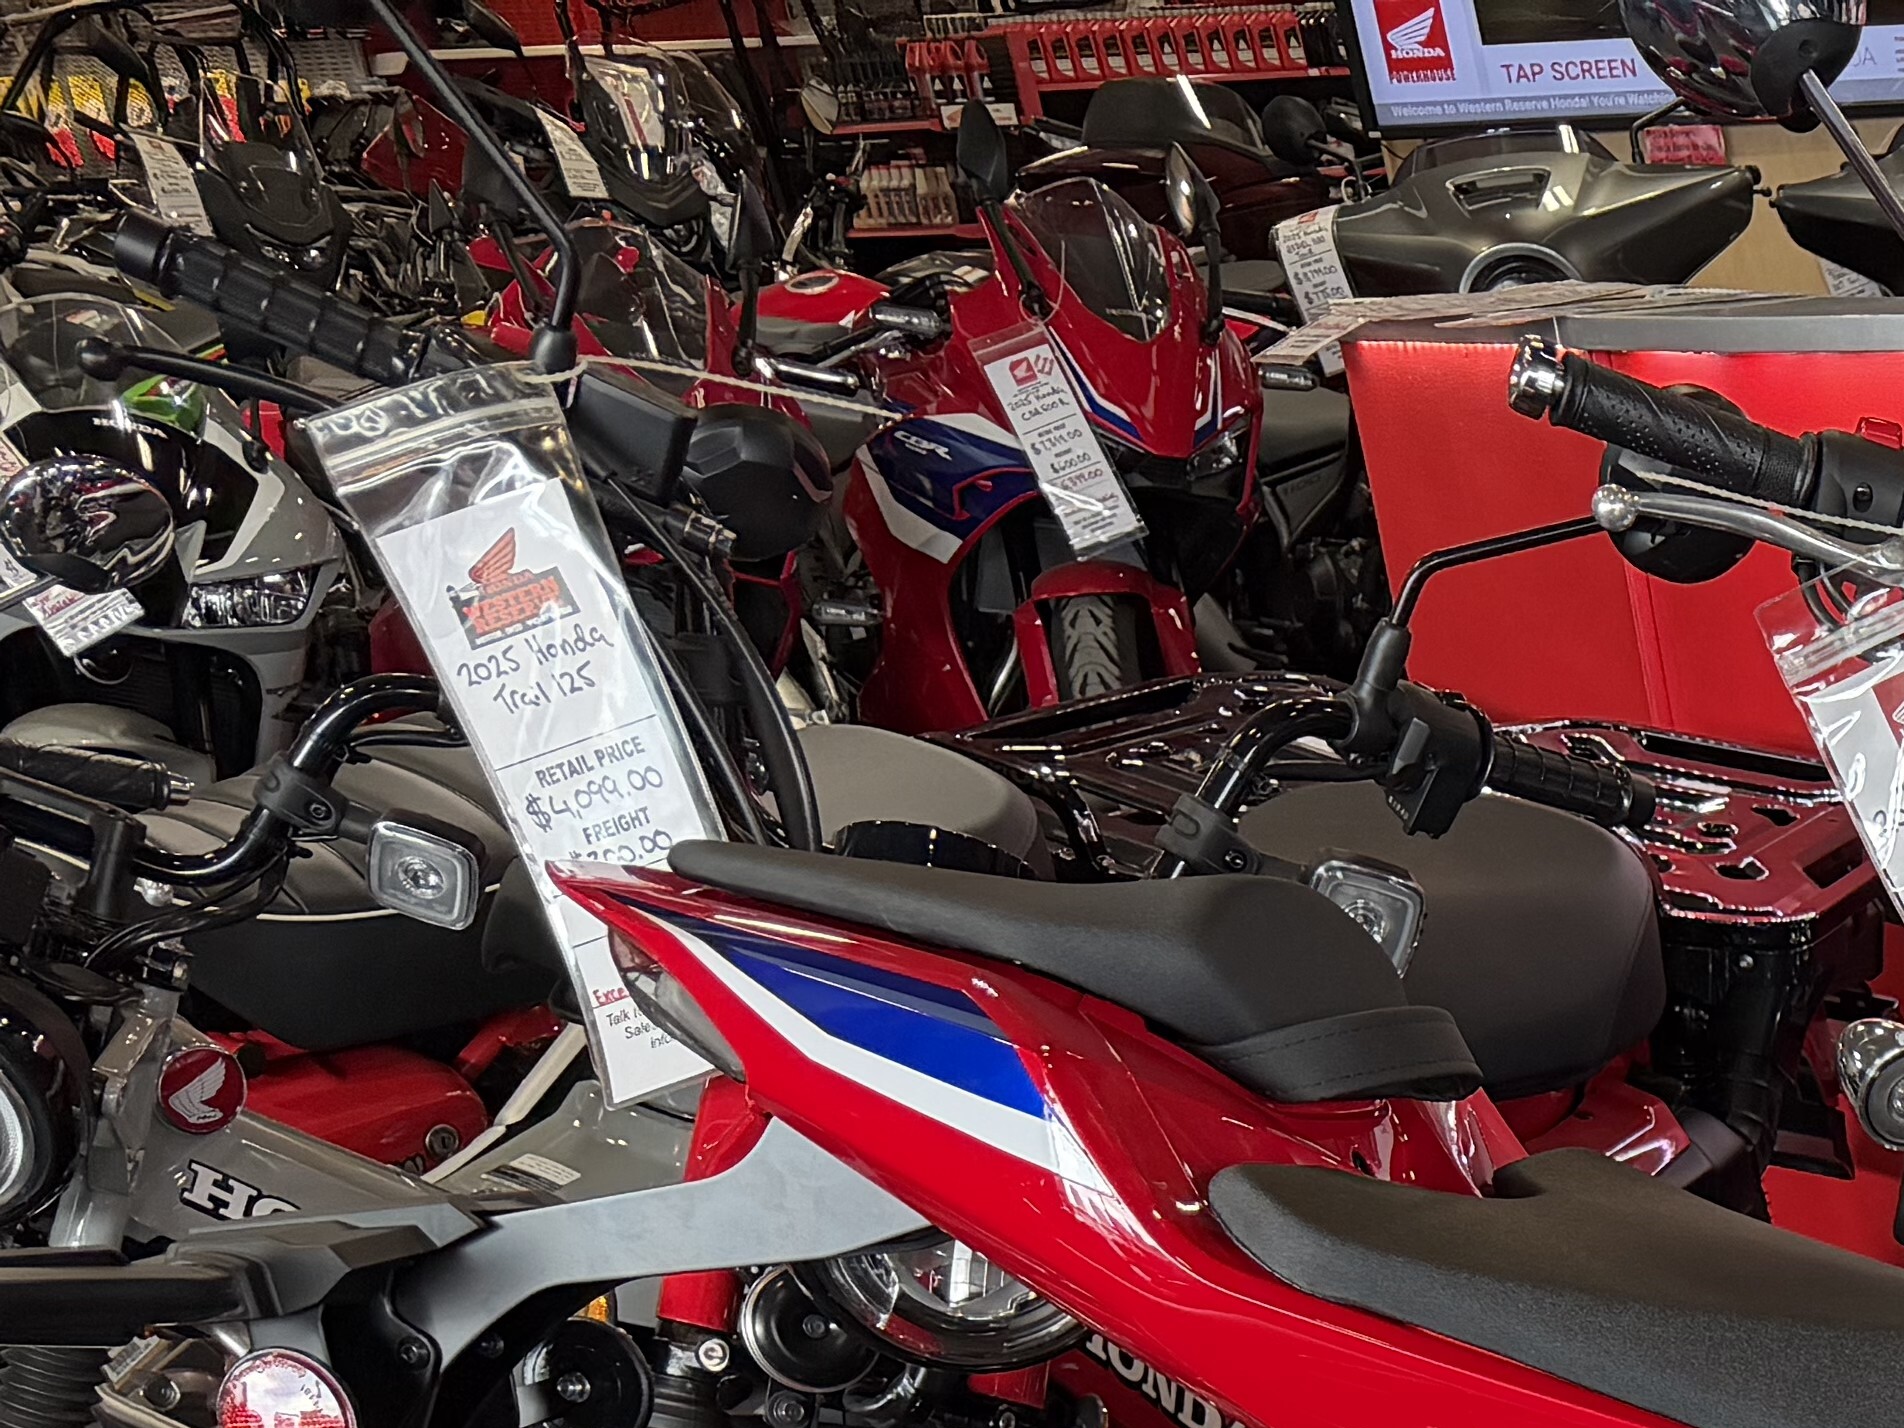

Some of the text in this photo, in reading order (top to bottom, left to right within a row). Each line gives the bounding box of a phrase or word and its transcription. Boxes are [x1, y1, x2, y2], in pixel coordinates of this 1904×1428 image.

[1391, 47, 1446, 59] HONDA
[1500, 58, 1637, 84] TAP SCREEN
[1389, 68, 1457, 85] POWERHOUSE
[1391, 104, 1442, 118] Welcome
[1445, 104, 1455, 115] to
[1457, 102, 1503, 115] Western
[1504, 99, 1549, 113] Reserve
[1591, 95, 1625, 107] You're
[894, 430, 953, 461] CBR
[463, 576, 562, 617] WESTERN
[472, 593, 560, 636] RESERVE
[457, 645, 521, 687] 2025
[525, 623, 615, 666] Honda
[493, 660, 596, 714] Trail 125
[534, 735, 646, 789] RETAIL PRICE
[525, 764, 664, 834] $4,099.00
[583, 806, 652, 845] FREIGHT
[606, 1009, 630, 1027] Talk
